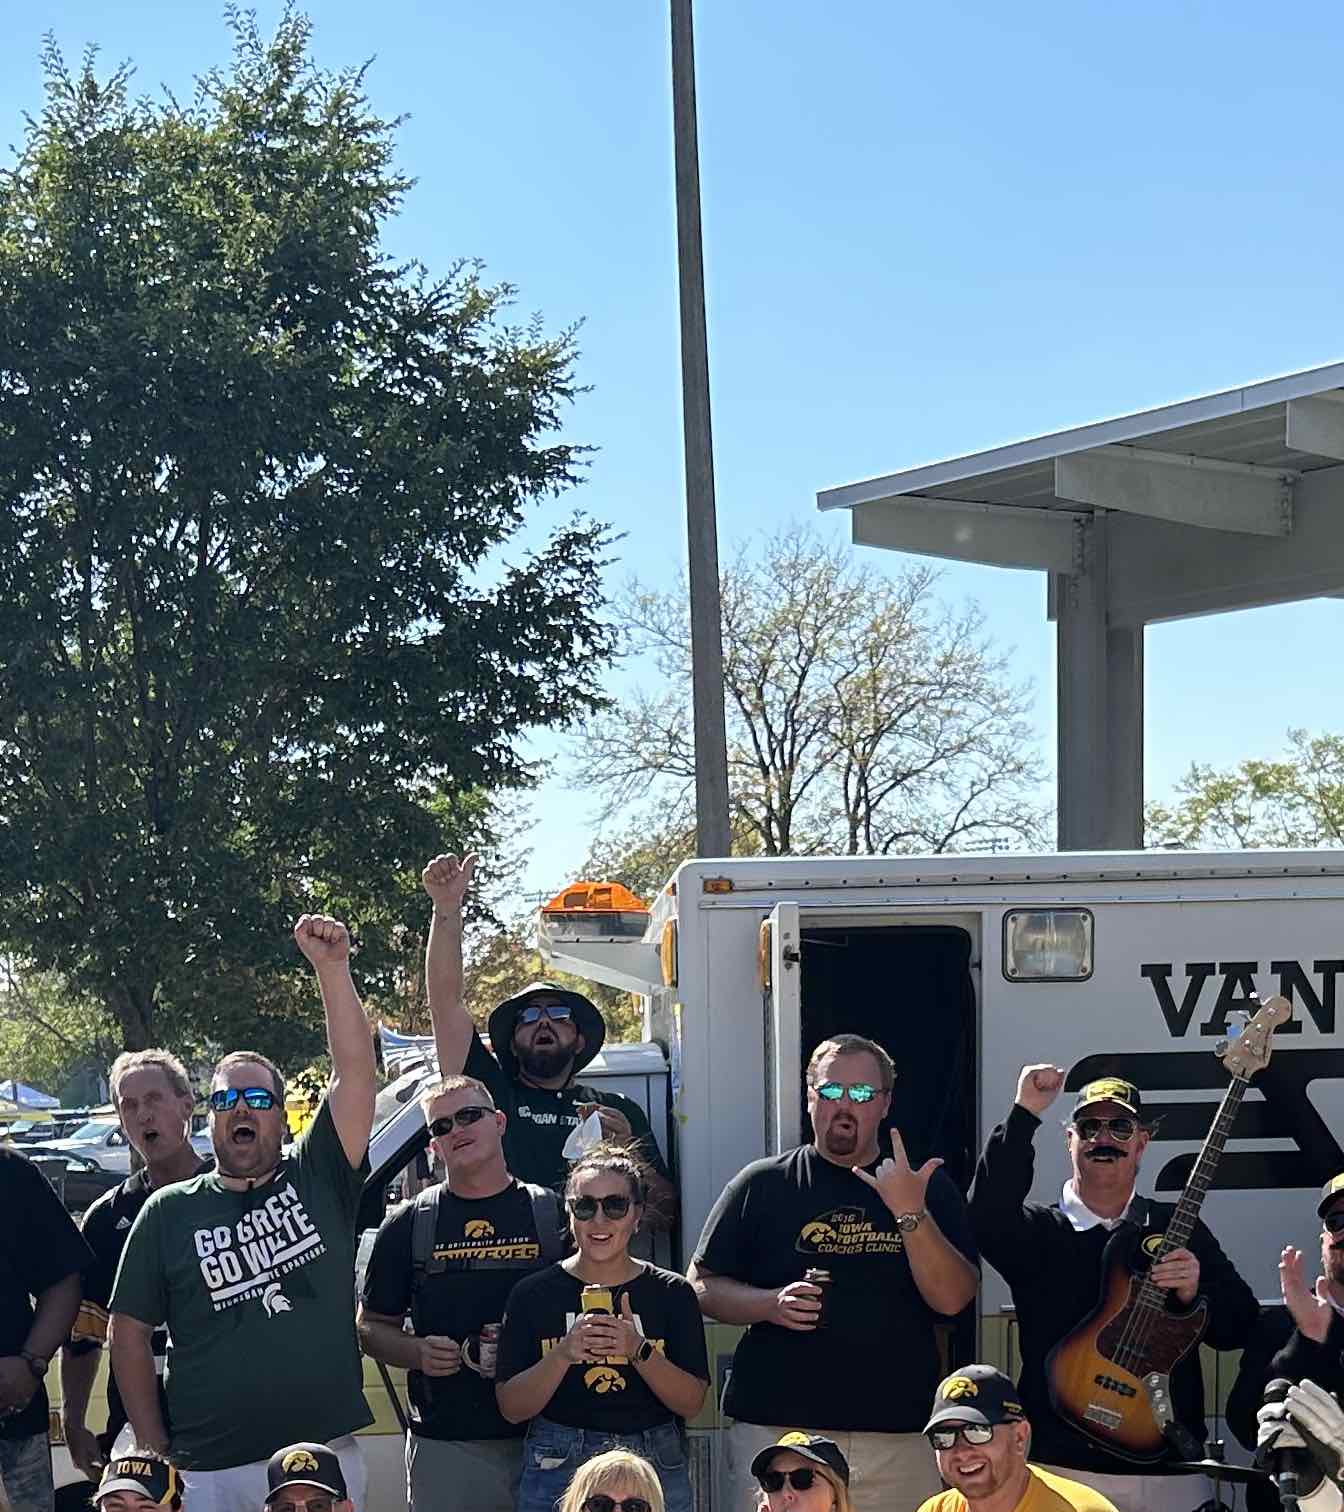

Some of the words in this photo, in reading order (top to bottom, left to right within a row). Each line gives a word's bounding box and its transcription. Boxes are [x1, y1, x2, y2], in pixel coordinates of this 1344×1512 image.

[194, 1226, 232, 1258] GO
[236, 1182, 299, 1244] GREN
[839, 1222, 873, 1234] IOWA
[200, 1250, 243, 1289] GO
[240, 1203, 316, 1276] WTE
[837, 1231, 903, 1245] FOOTBALL
[436, 1245, 538, 1261] AWKEYES
[865, 1242, 902, 1253] CLINIC
[117, 1460, 153, 1477] IOWA
